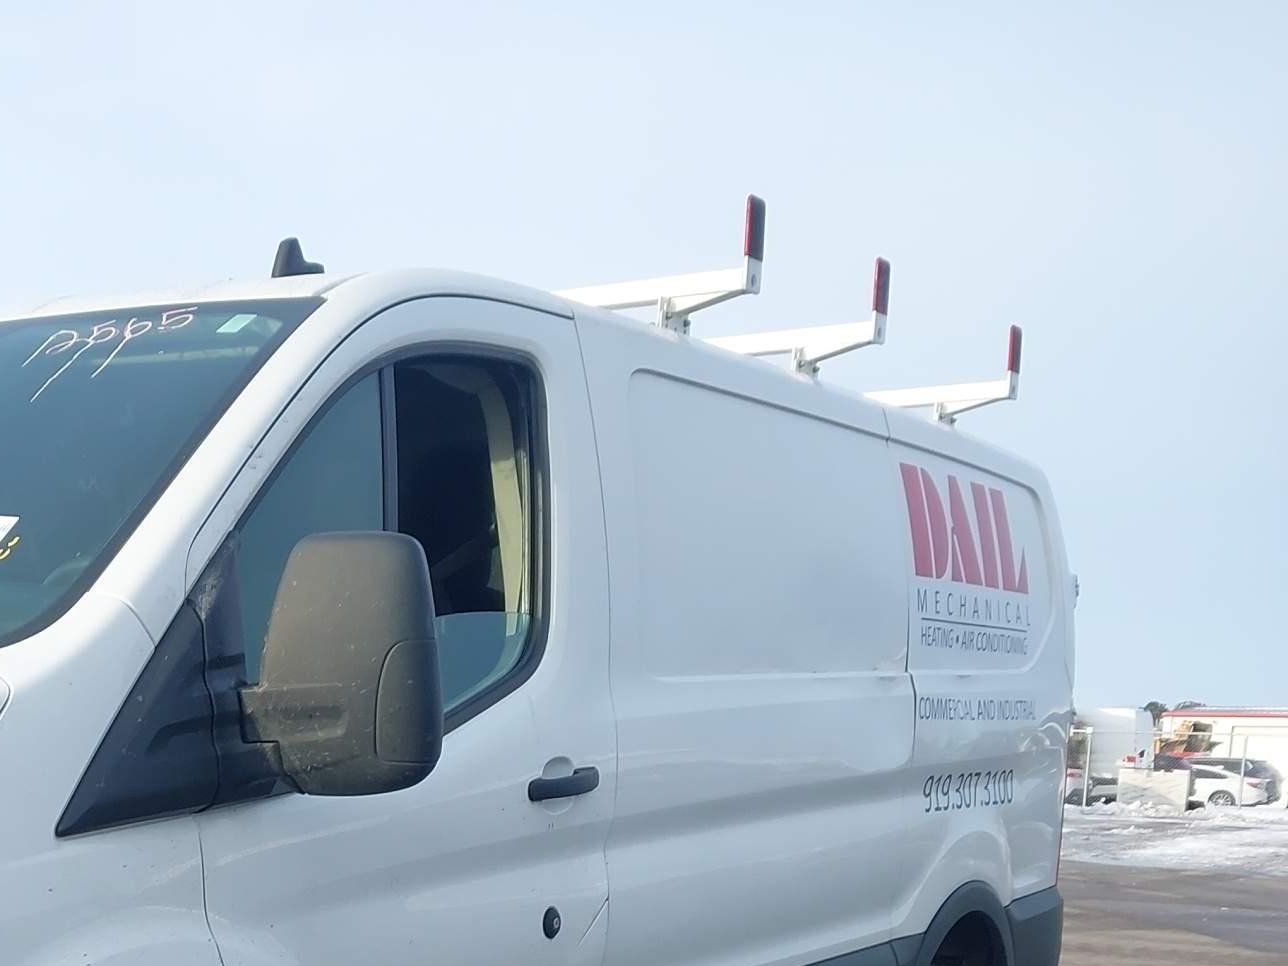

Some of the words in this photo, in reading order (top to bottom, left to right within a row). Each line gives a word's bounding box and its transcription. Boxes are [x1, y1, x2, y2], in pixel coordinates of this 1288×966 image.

[899, 462, 1029, 594] DAIL
[916, 587, 1031, 626] MECHANICAL
[920, 625, 954, 649] HEATING
[960, 630, 975, 651] AIR
[918, 696, 976, 721] COMMERCIAL
[977, 698, 996, 721] AND
[922, 768, 1014, 814] 919.307.3100
